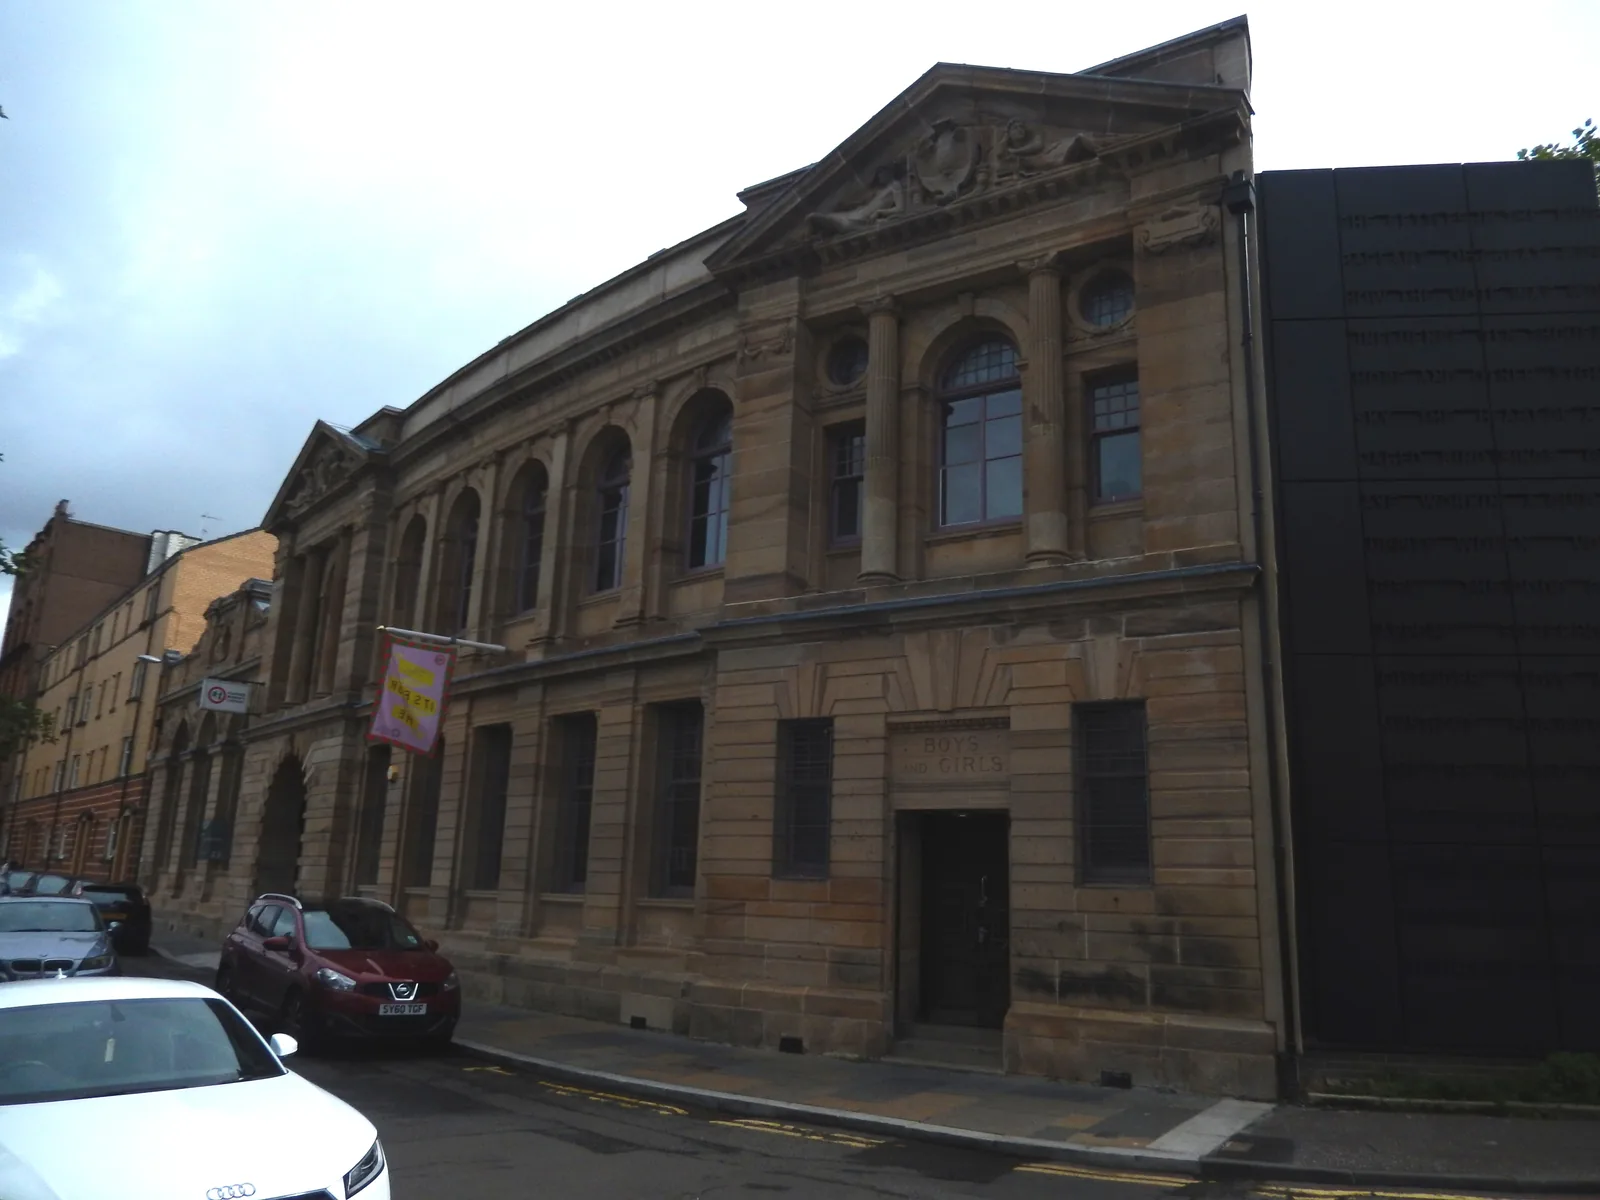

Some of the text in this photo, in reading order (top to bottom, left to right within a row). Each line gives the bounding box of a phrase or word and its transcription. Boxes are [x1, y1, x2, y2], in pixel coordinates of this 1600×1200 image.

[924, 736, 978, 753] BOYS
[939, 756, 1003, 773] GIRLS
[383, 1005, 424, 1013] SY60 TGF
